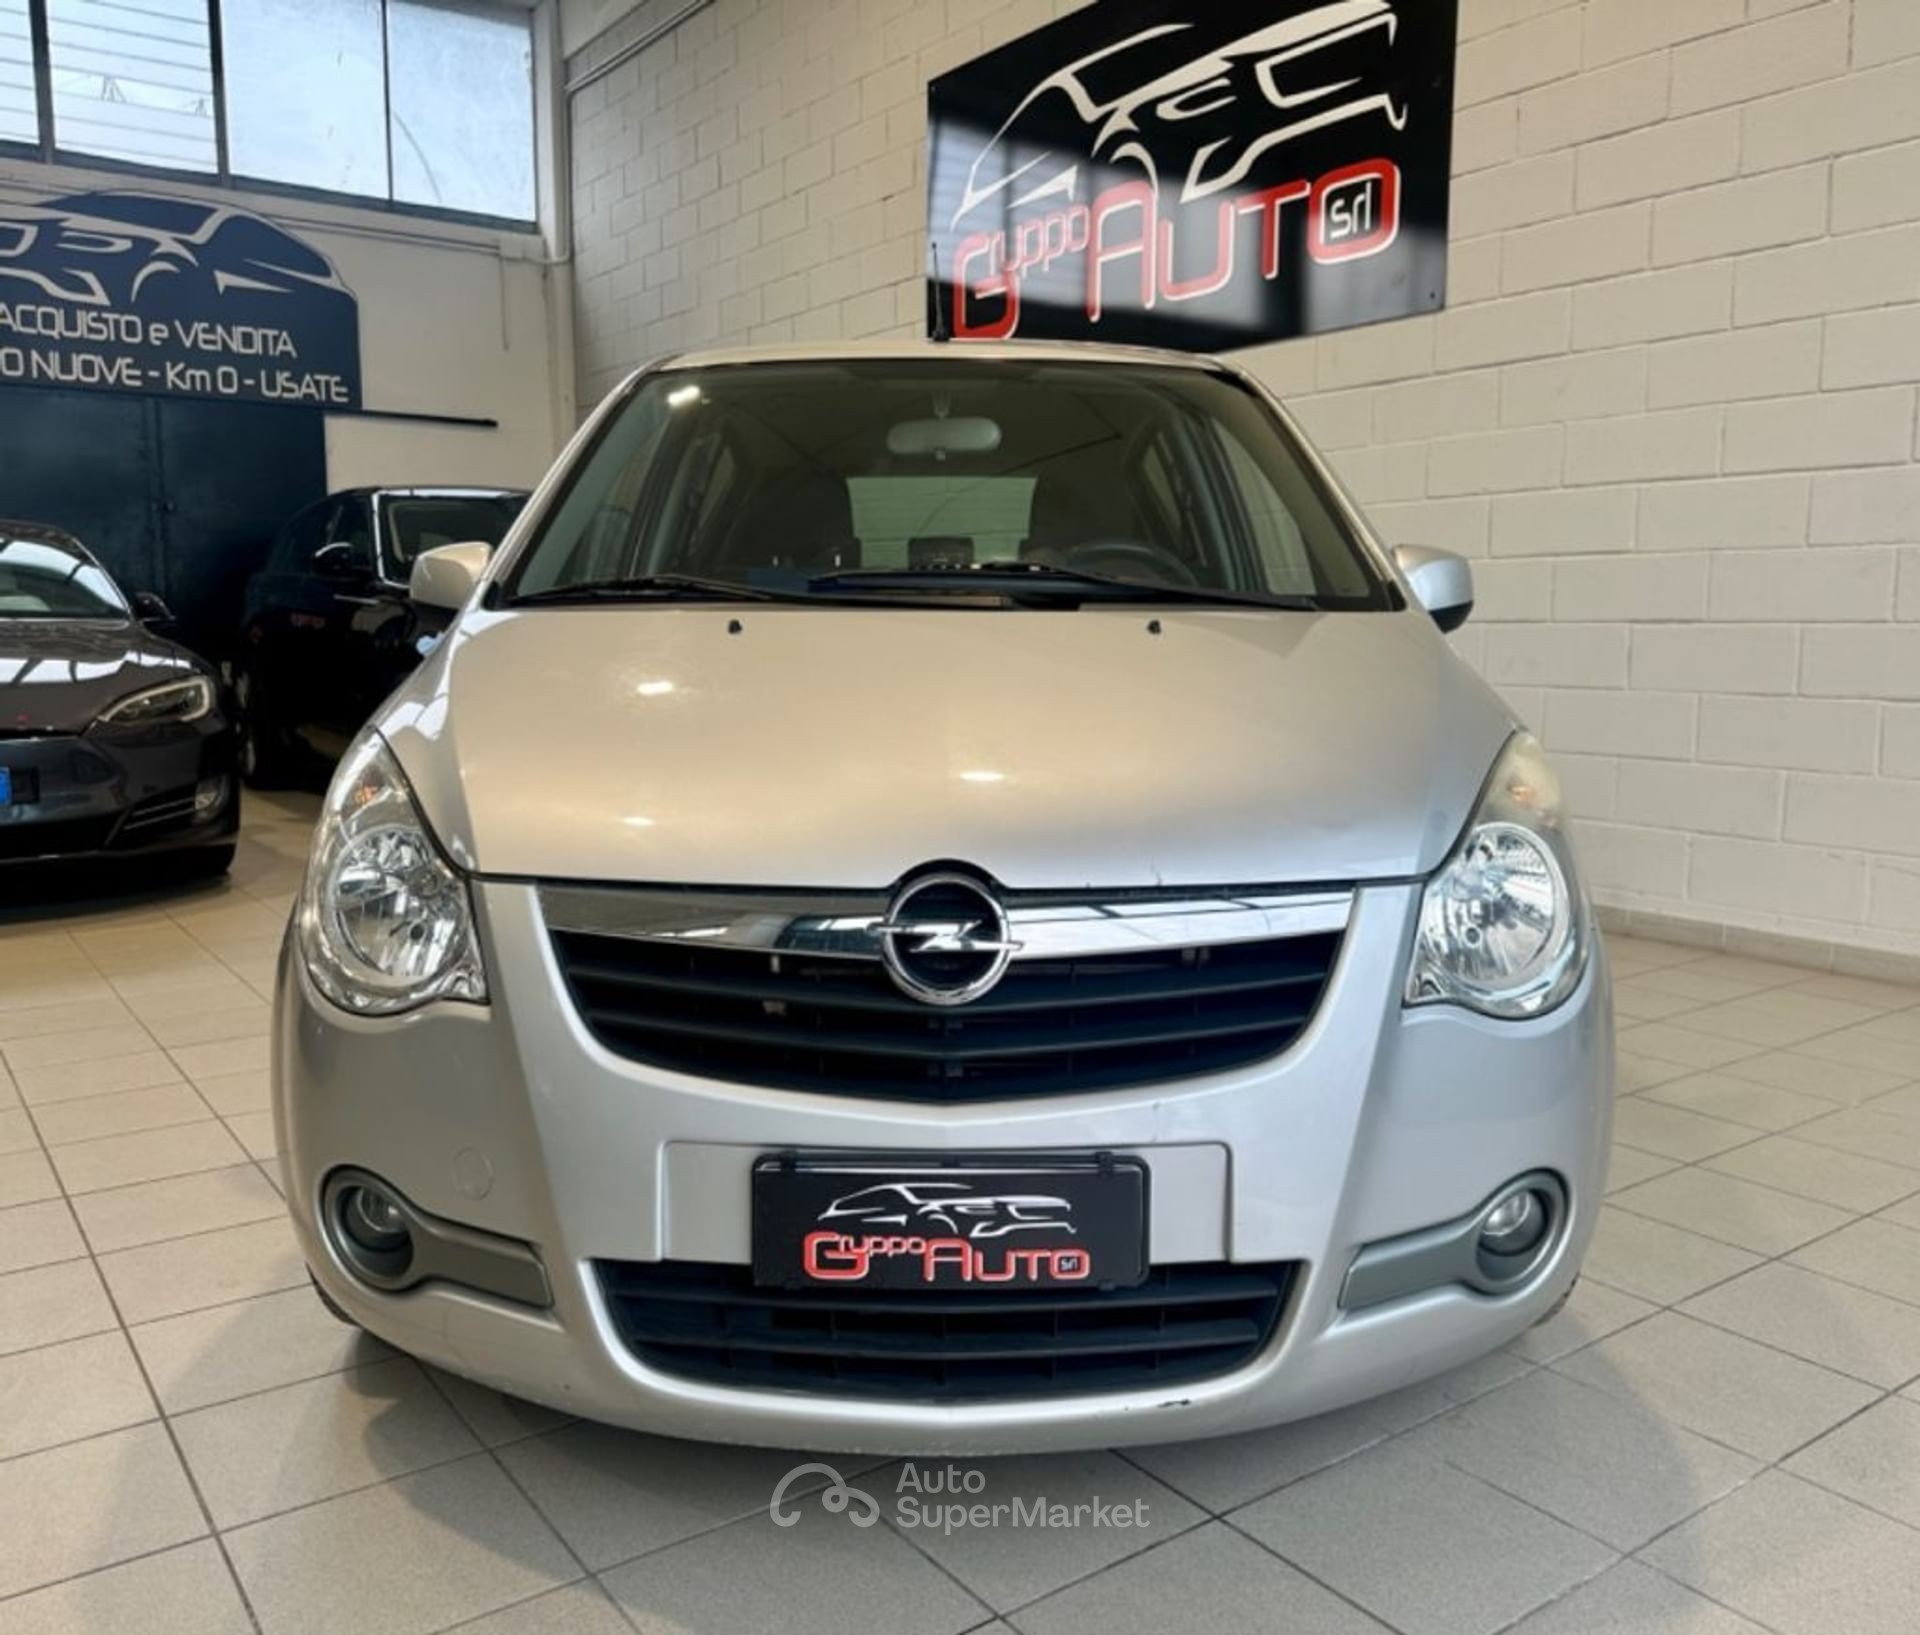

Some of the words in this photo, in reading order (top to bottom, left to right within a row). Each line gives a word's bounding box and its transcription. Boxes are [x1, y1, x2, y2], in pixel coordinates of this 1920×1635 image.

[953, 203, 1090, 340] Gruppo
[1087, 157, 1402, 323] AUTO
[0, 303, 142, 344] ACQUISTO
[149, 321, 170, 346] e
[174, 319, 298, 358] VENDITA
[31, 350, 143, 387] NUOVE
[165, 361, 212, 392] Km
[260, 369, 349, 402] USATE
[804, 1231, 926, 1280] Gruppo
[923, 1238, 1090, 1282] AUTO
